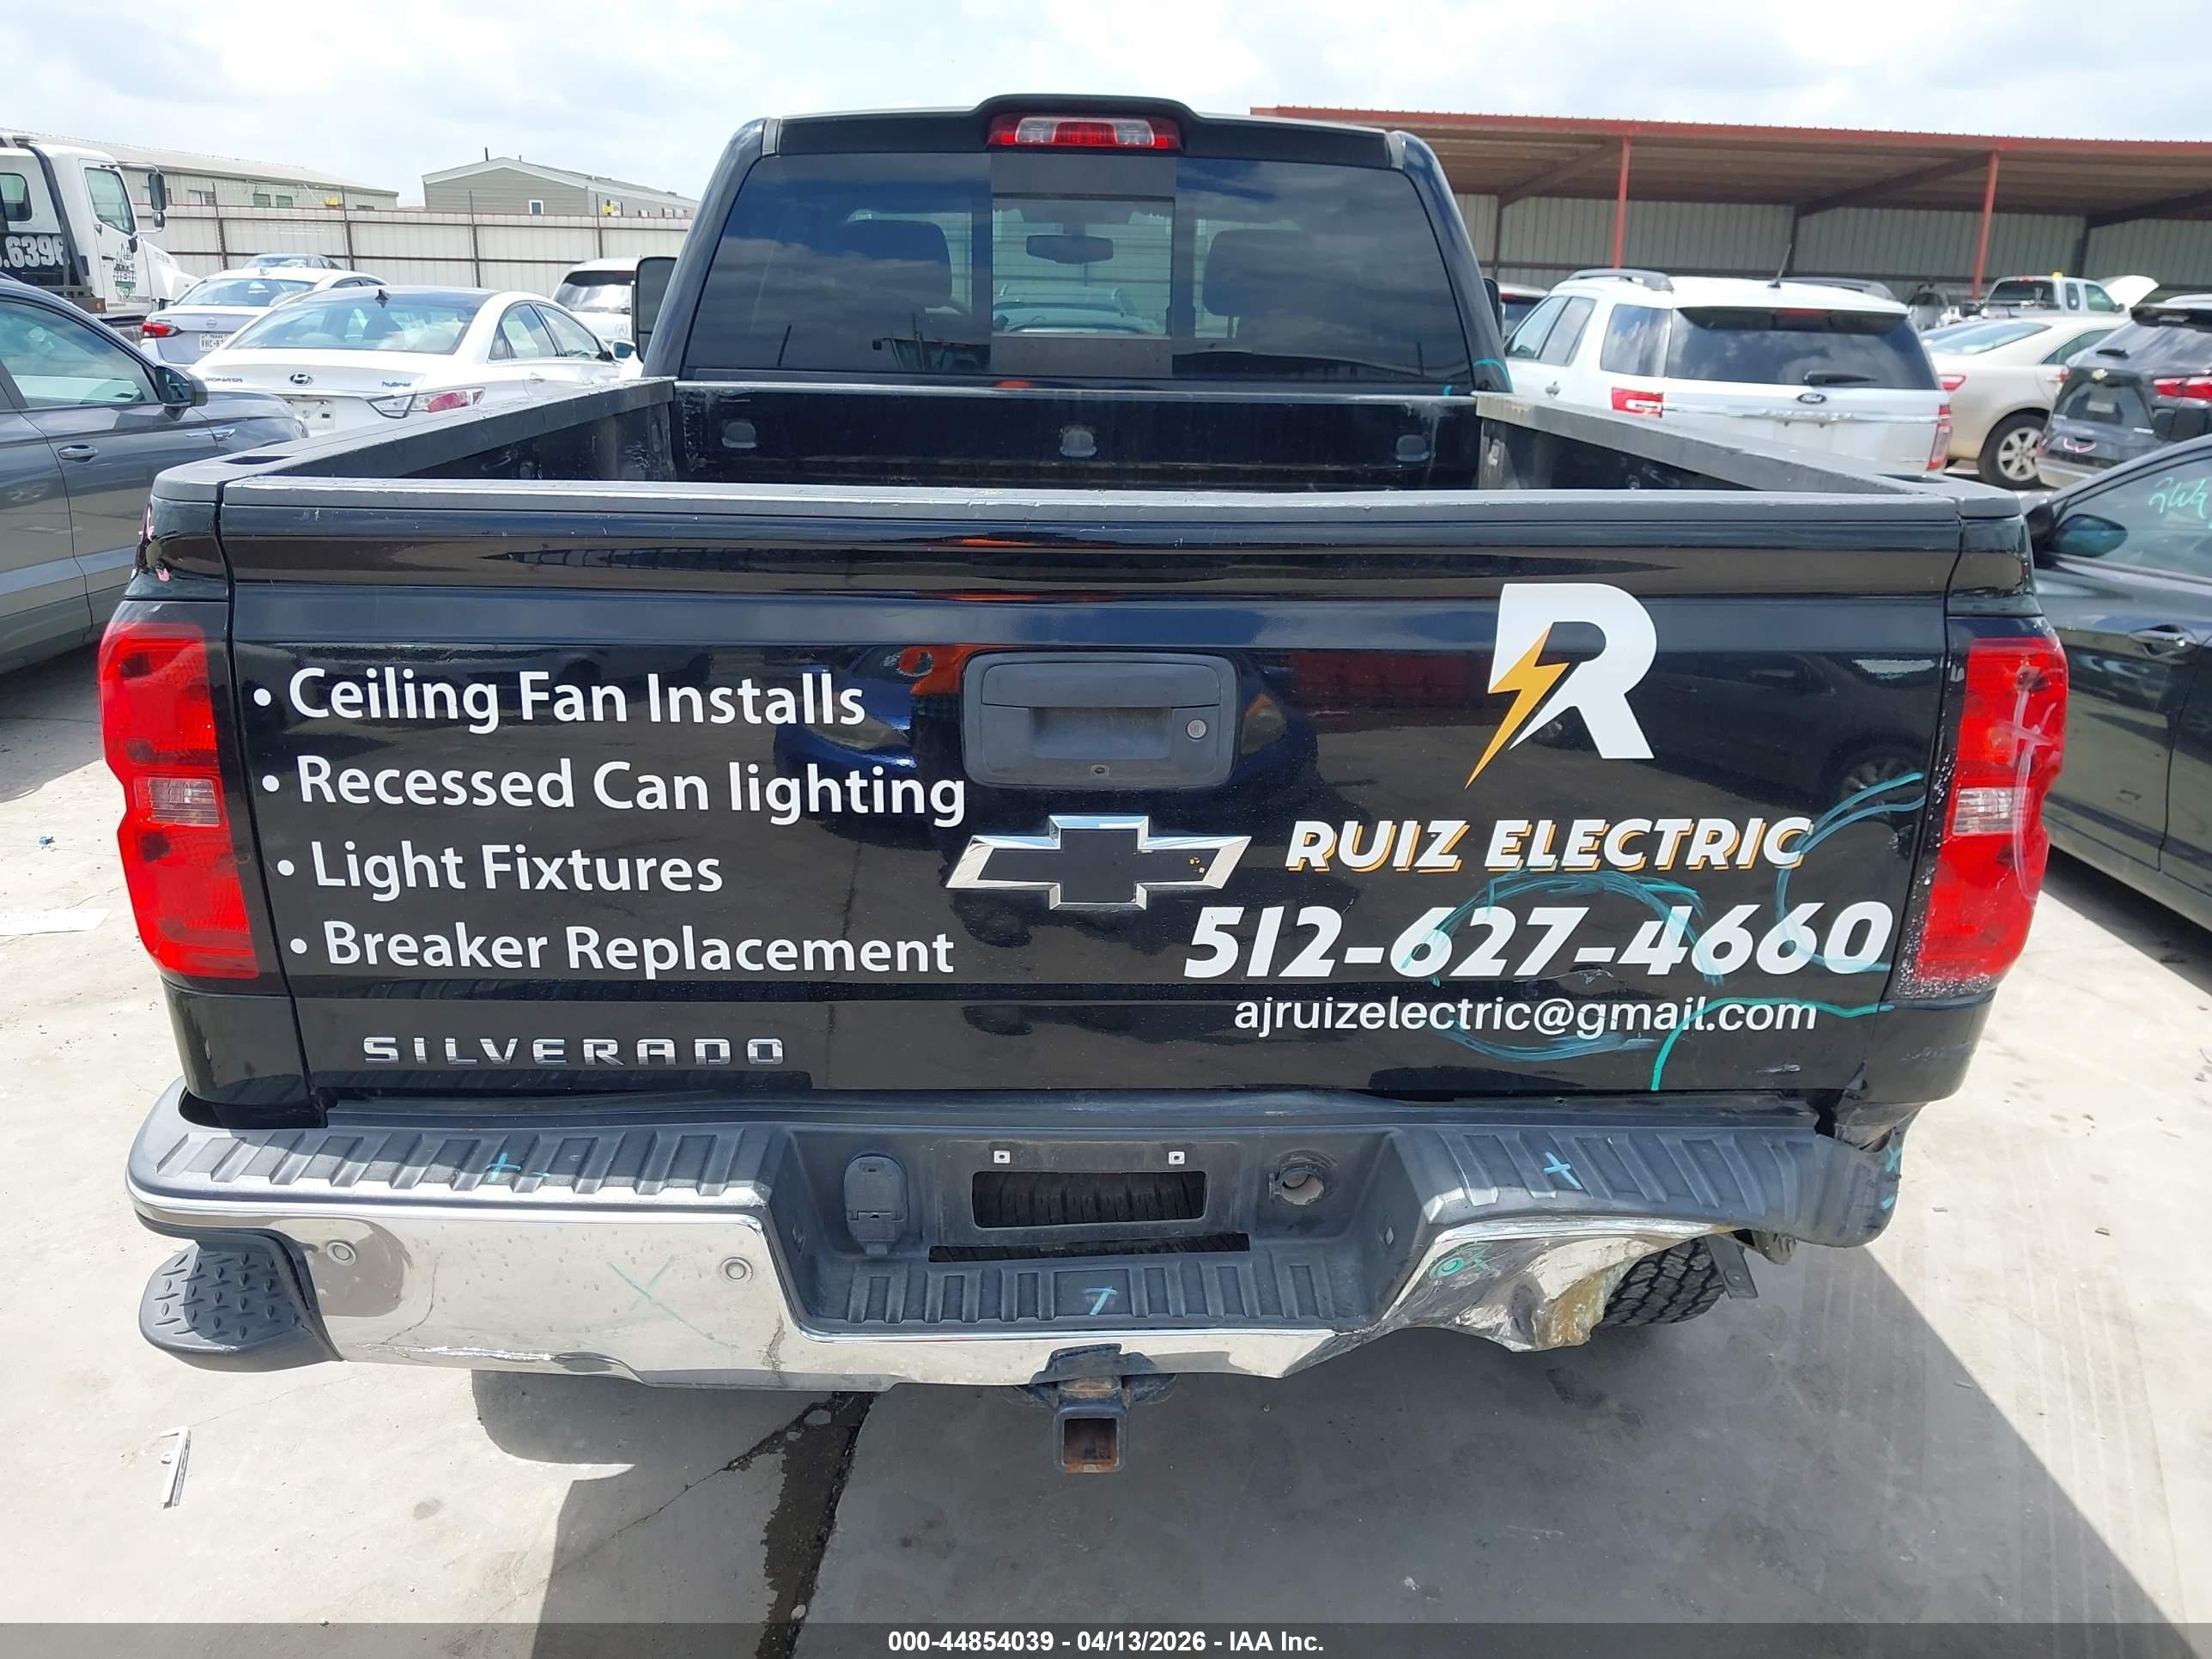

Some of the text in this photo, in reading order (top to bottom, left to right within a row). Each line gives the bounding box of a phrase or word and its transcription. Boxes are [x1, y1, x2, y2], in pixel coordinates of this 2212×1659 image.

[289, 665, 866, 735] Ceiling Fan Installs
[1488, 581, 1657, 759] R
[297, 754, 965, 828] Recessed Can lighting
[311, 840, 723, 902] Light Fixtures
[1285, 817, 1814, 872] RUIZ ELECTRIC
[324, 921, 955, 980] Breaker Replacement
[1182, 901, 1893, 978] 512-627-4660
[1234, 995, 1818, 1040] ajruizelectric@gmail.com
[362, 1036, 786, 1066] SILVERADO
